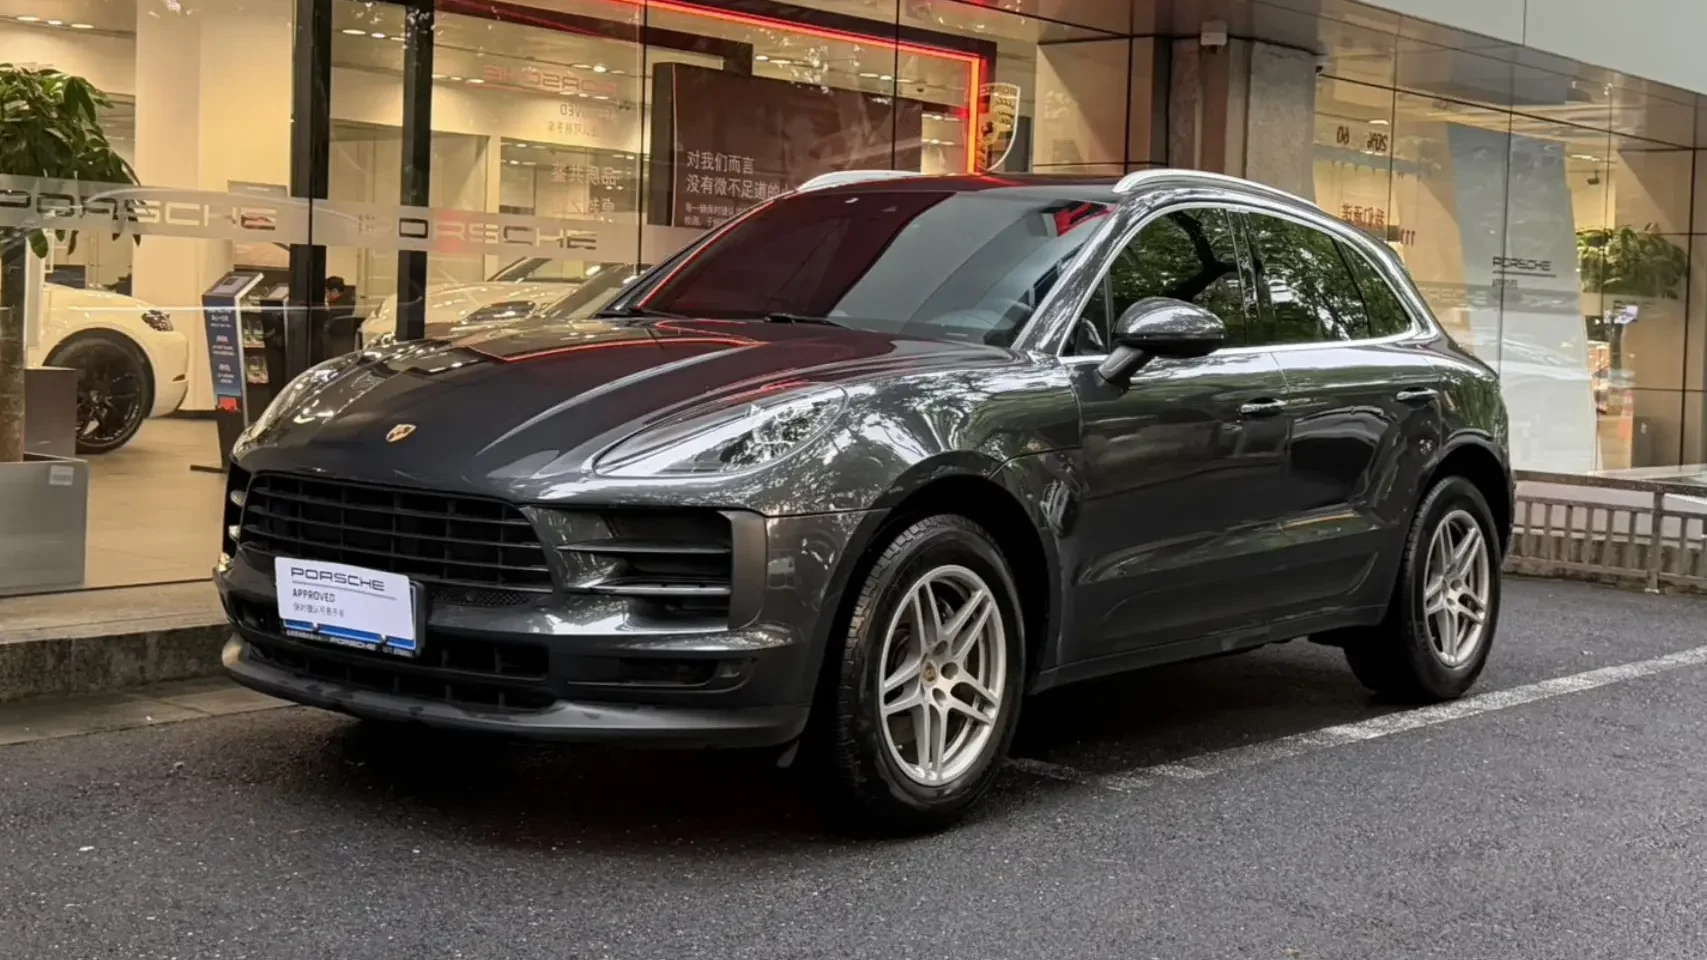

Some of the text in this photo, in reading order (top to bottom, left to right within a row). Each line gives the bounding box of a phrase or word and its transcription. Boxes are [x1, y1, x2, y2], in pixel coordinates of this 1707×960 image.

[686, 150, 755, 175] 对我们而言
[0, 189, 277, 231] PORSCHE
[1492, 256, 1552, 272] PORSCHE
[291, 567, 385, 592] PORSCHE
[292, 588, 336, 603] APPROVED
